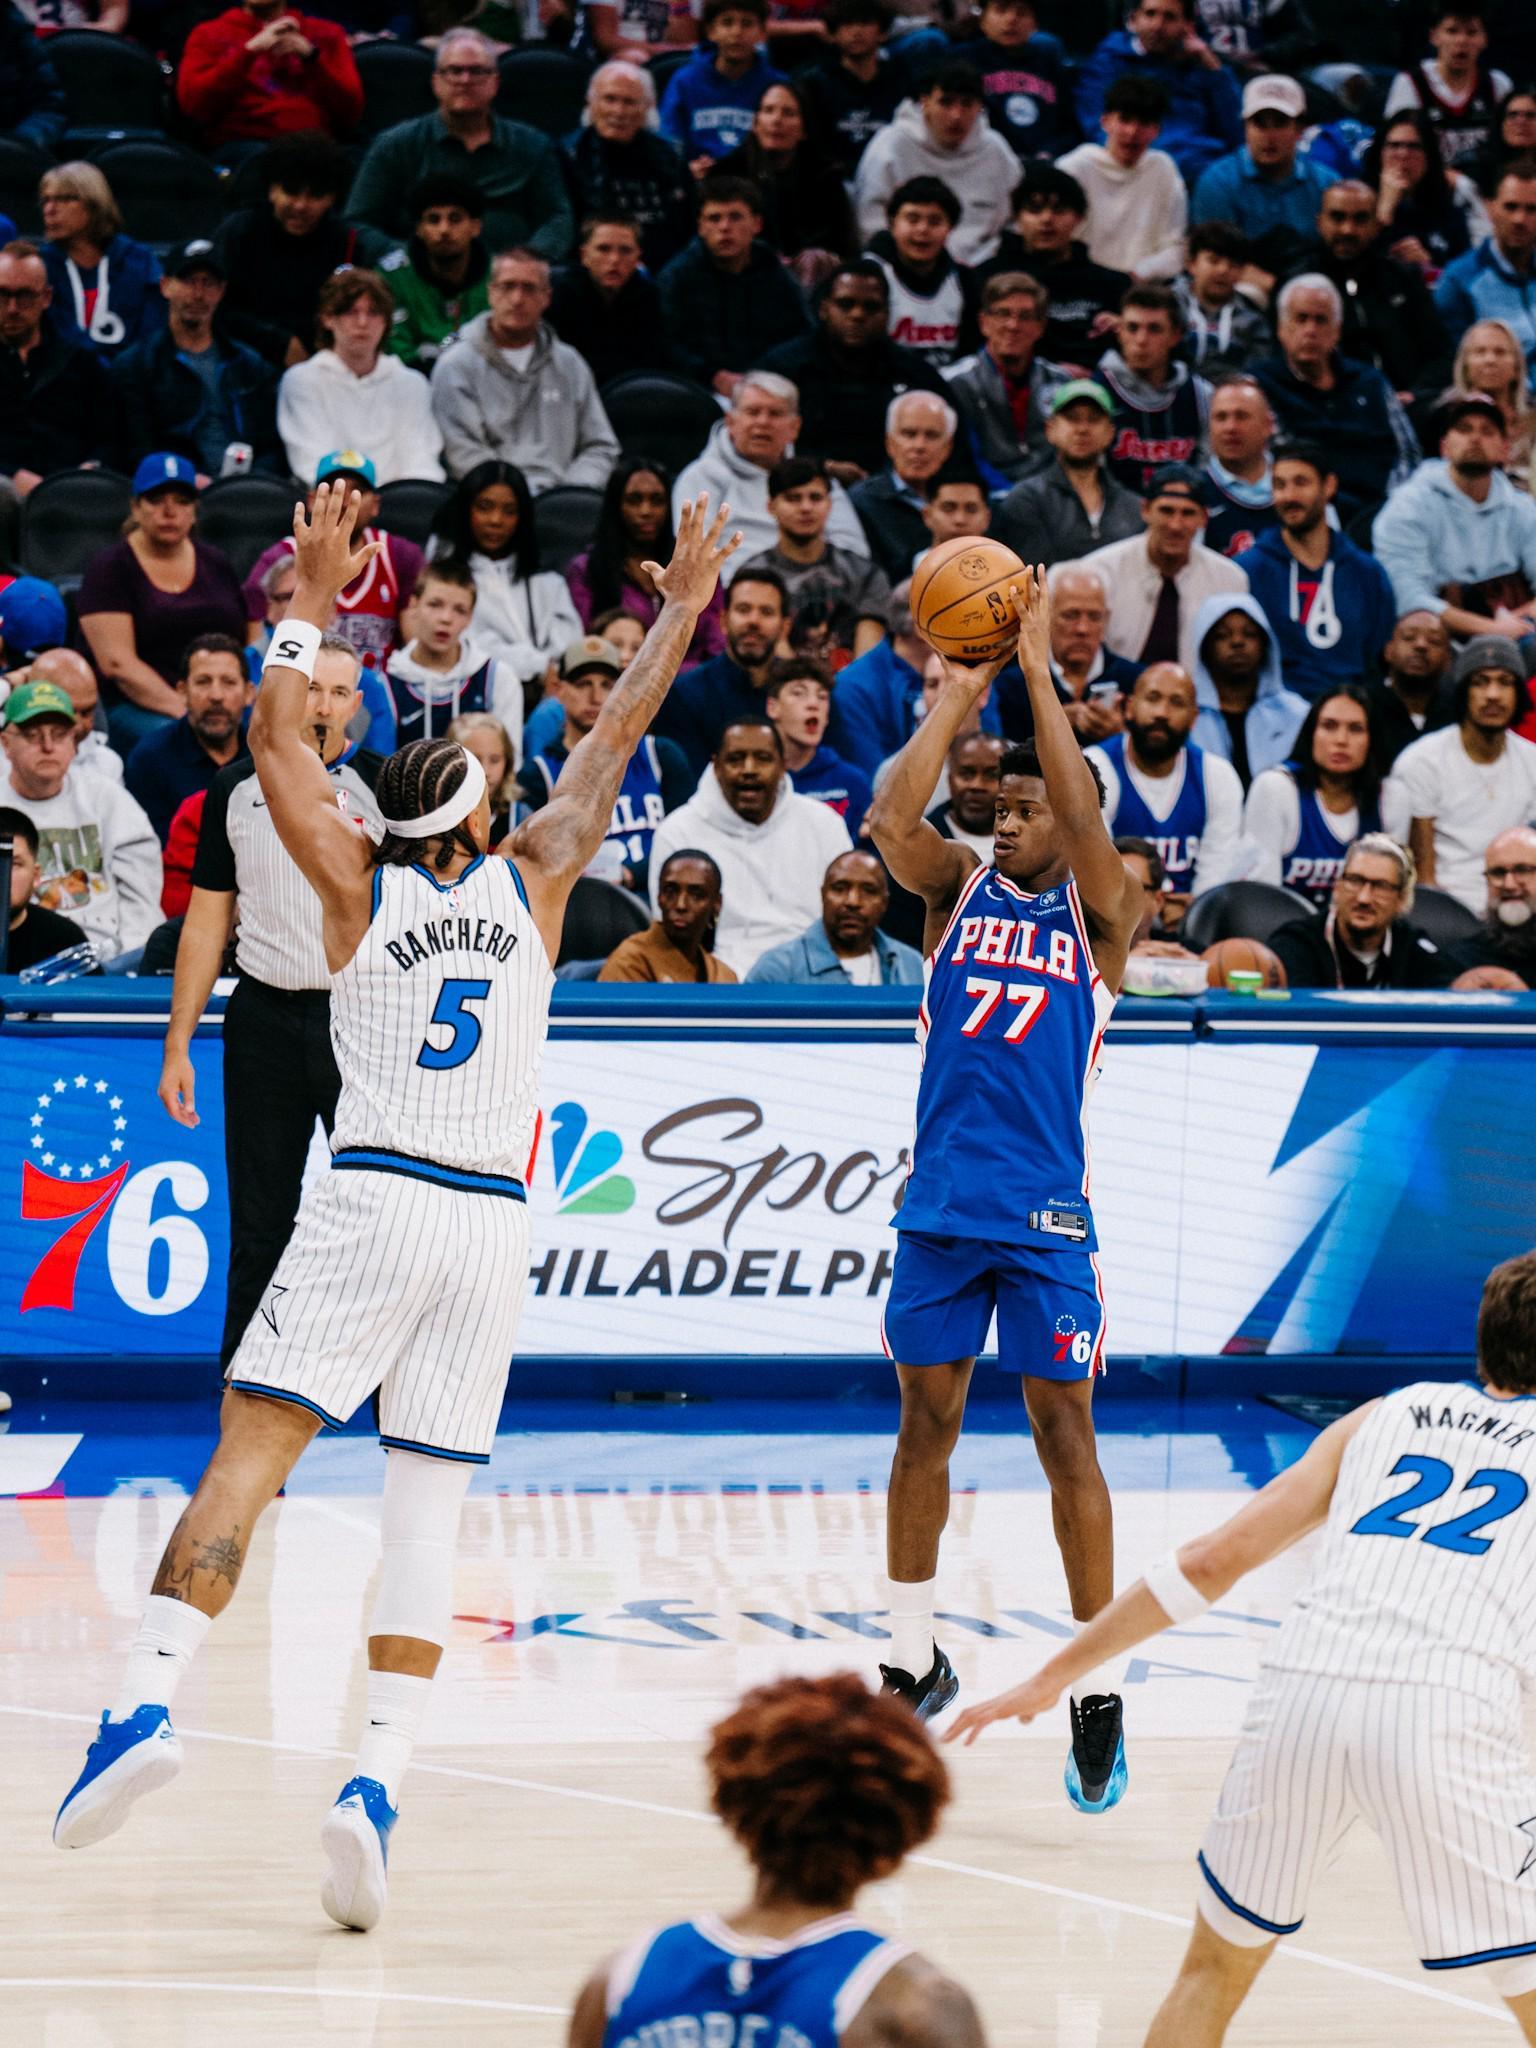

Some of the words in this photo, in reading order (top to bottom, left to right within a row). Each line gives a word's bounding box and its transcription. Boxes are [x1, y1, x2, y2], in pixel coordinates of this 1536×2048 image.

[275, 640, 304, 661] 5
[385, 918, 518, 972] BANCHERO
[951, 915, 1079, 985] PHILA
[416, 978, 493, 1071] 5
[961, 976, 1049, 1044] 77
[20, 1160, 210, 1316] 76
[529, 1249, 893, 1297] HILADELPH
[1053, 1331, 1091, 1363] 76
[1409, 1405, 1536, 1449] WAGNER
[1349, 1454, 1529, 1556] 22
